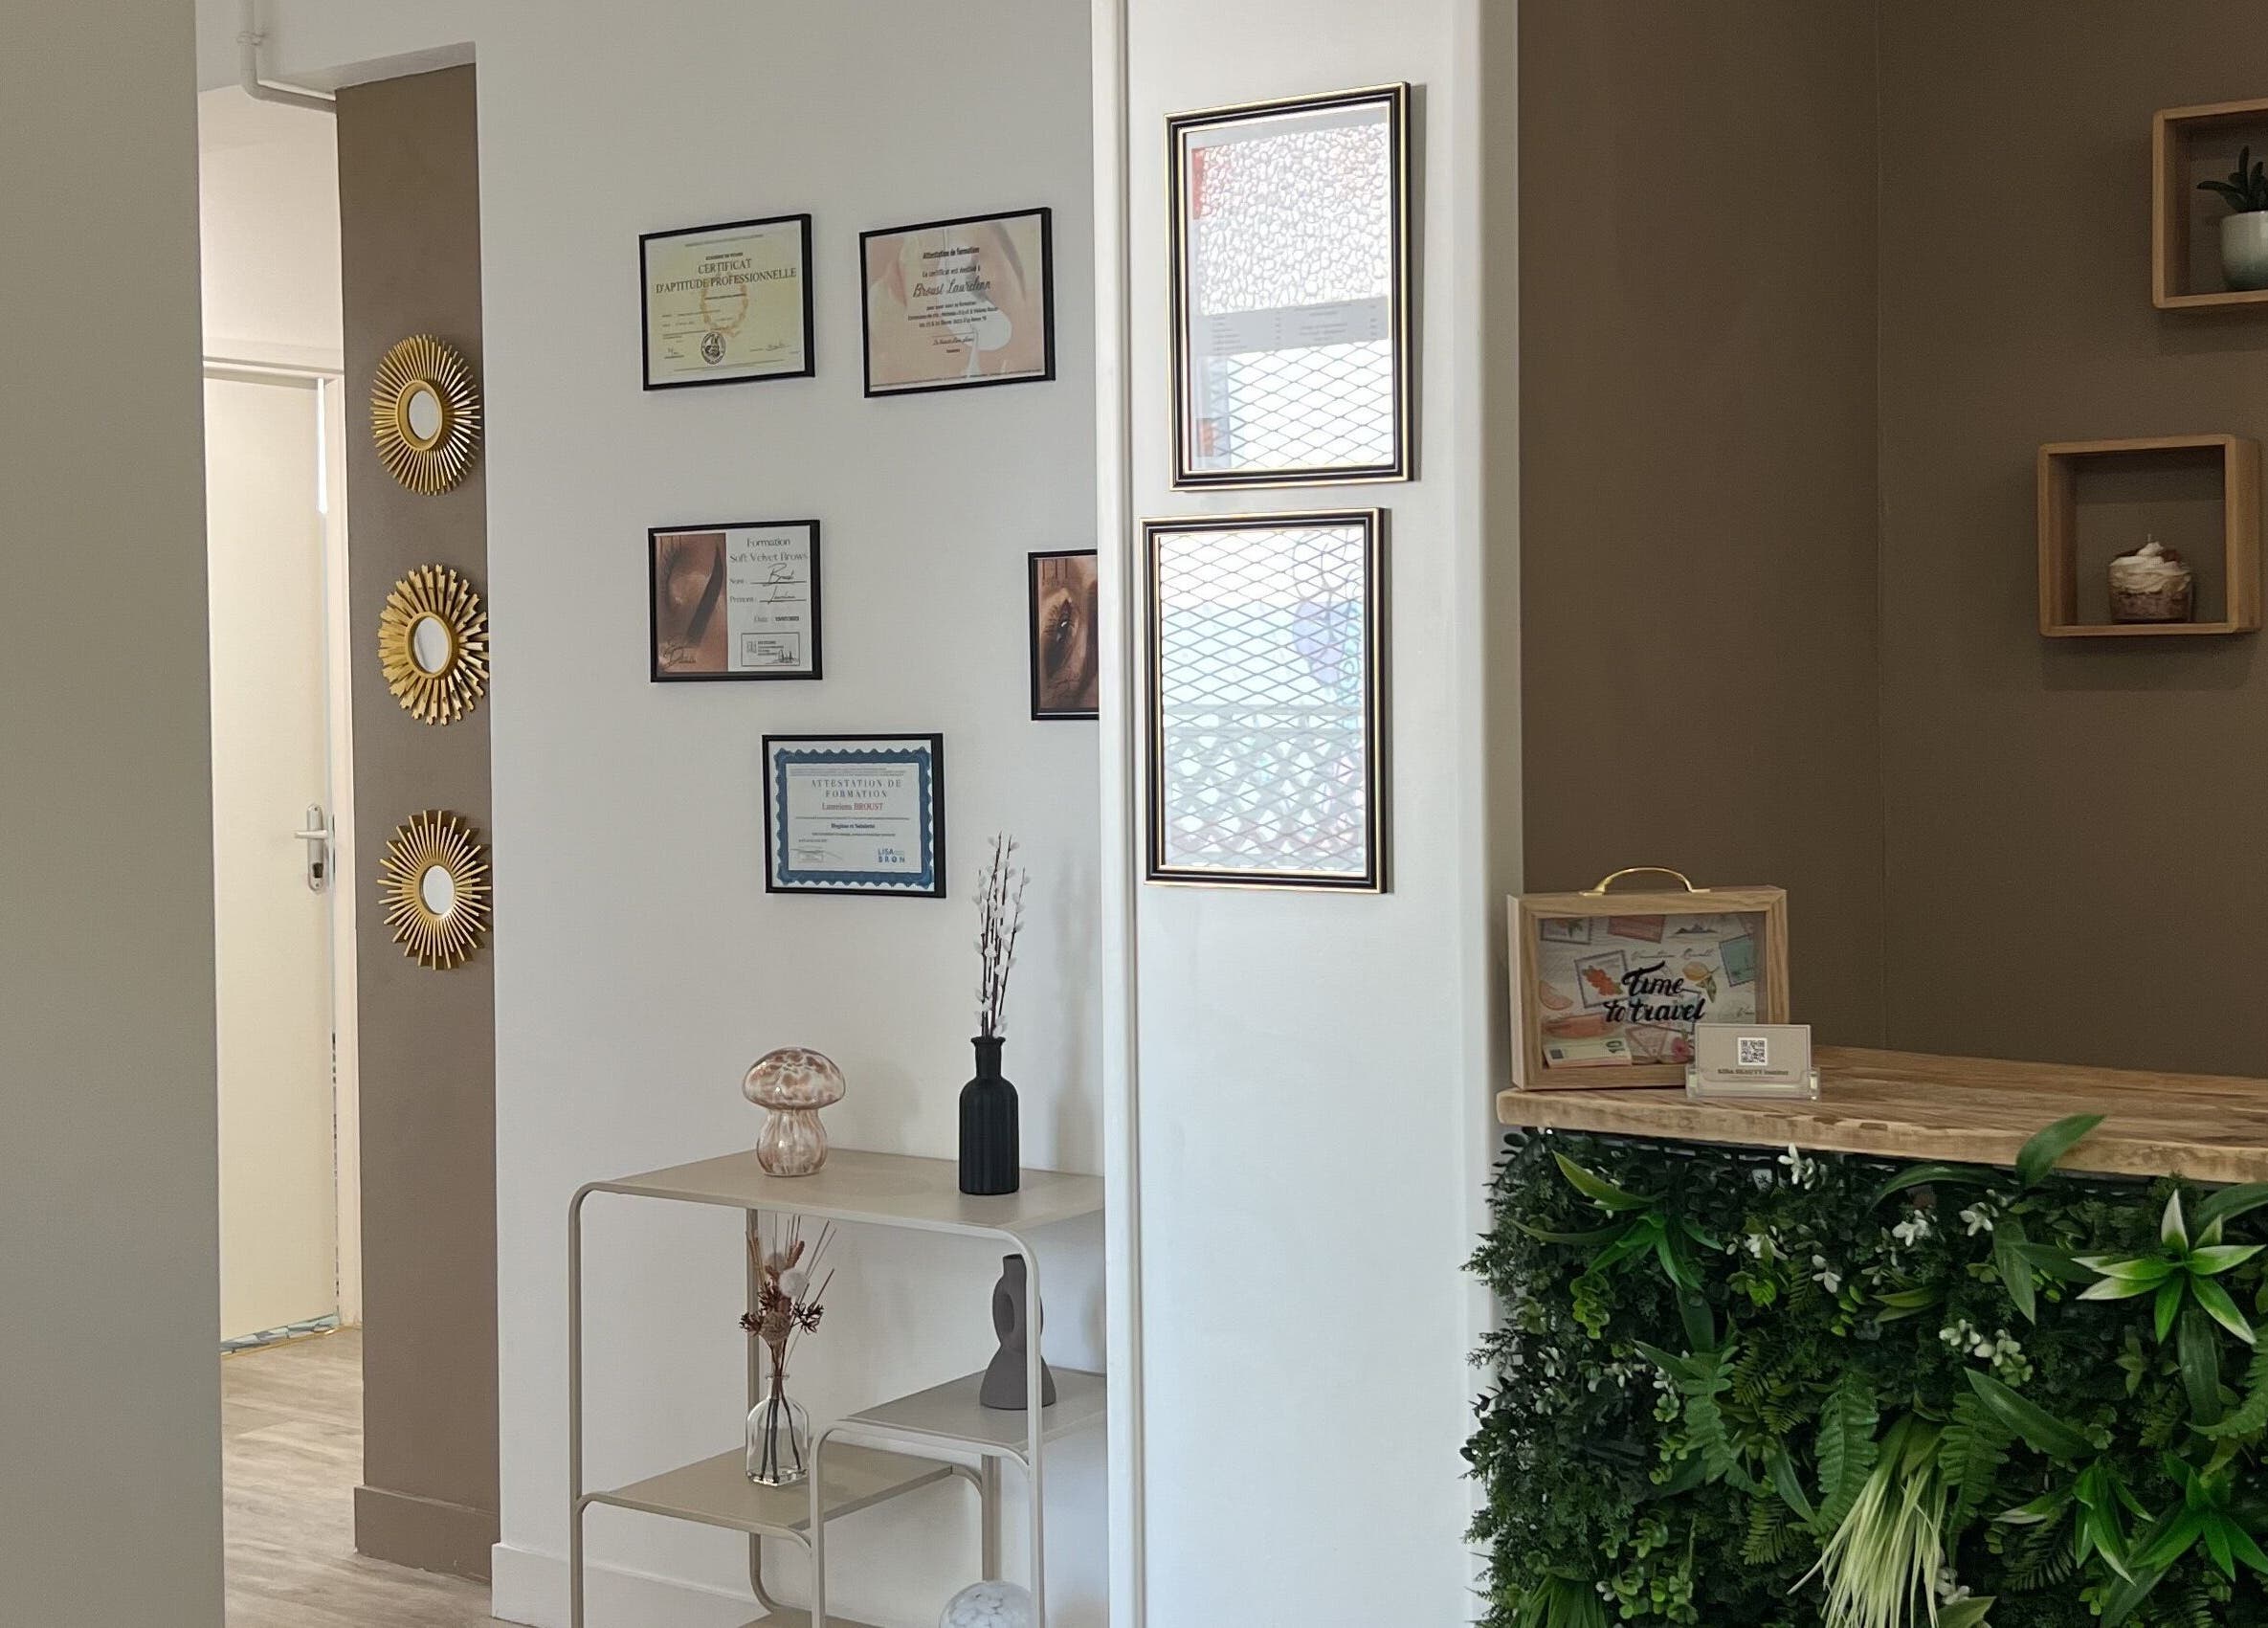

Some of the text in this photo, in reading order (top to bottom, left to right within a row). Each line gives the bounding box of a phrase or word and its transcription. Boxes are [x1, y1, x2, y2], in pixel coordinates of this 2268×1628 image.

[698, 258, 752, 275] CERTIFICAT
[656, 267, 797, 294] D'APTITUDE PROFESSIONNELLE
[746, 538, 790, 548] Formation
[749, 552, 778, 563] Velvet
[780, 551, 809, 562] Brows
[811, 779, 902, 789] ATTESTATION DE
[825, 790, 888, 798] FORMATION
[854, 802, 884, 811] BROUST
[1621, 960, 1684, 996] Time
[1603, 997, 1706, 1024] to travel
